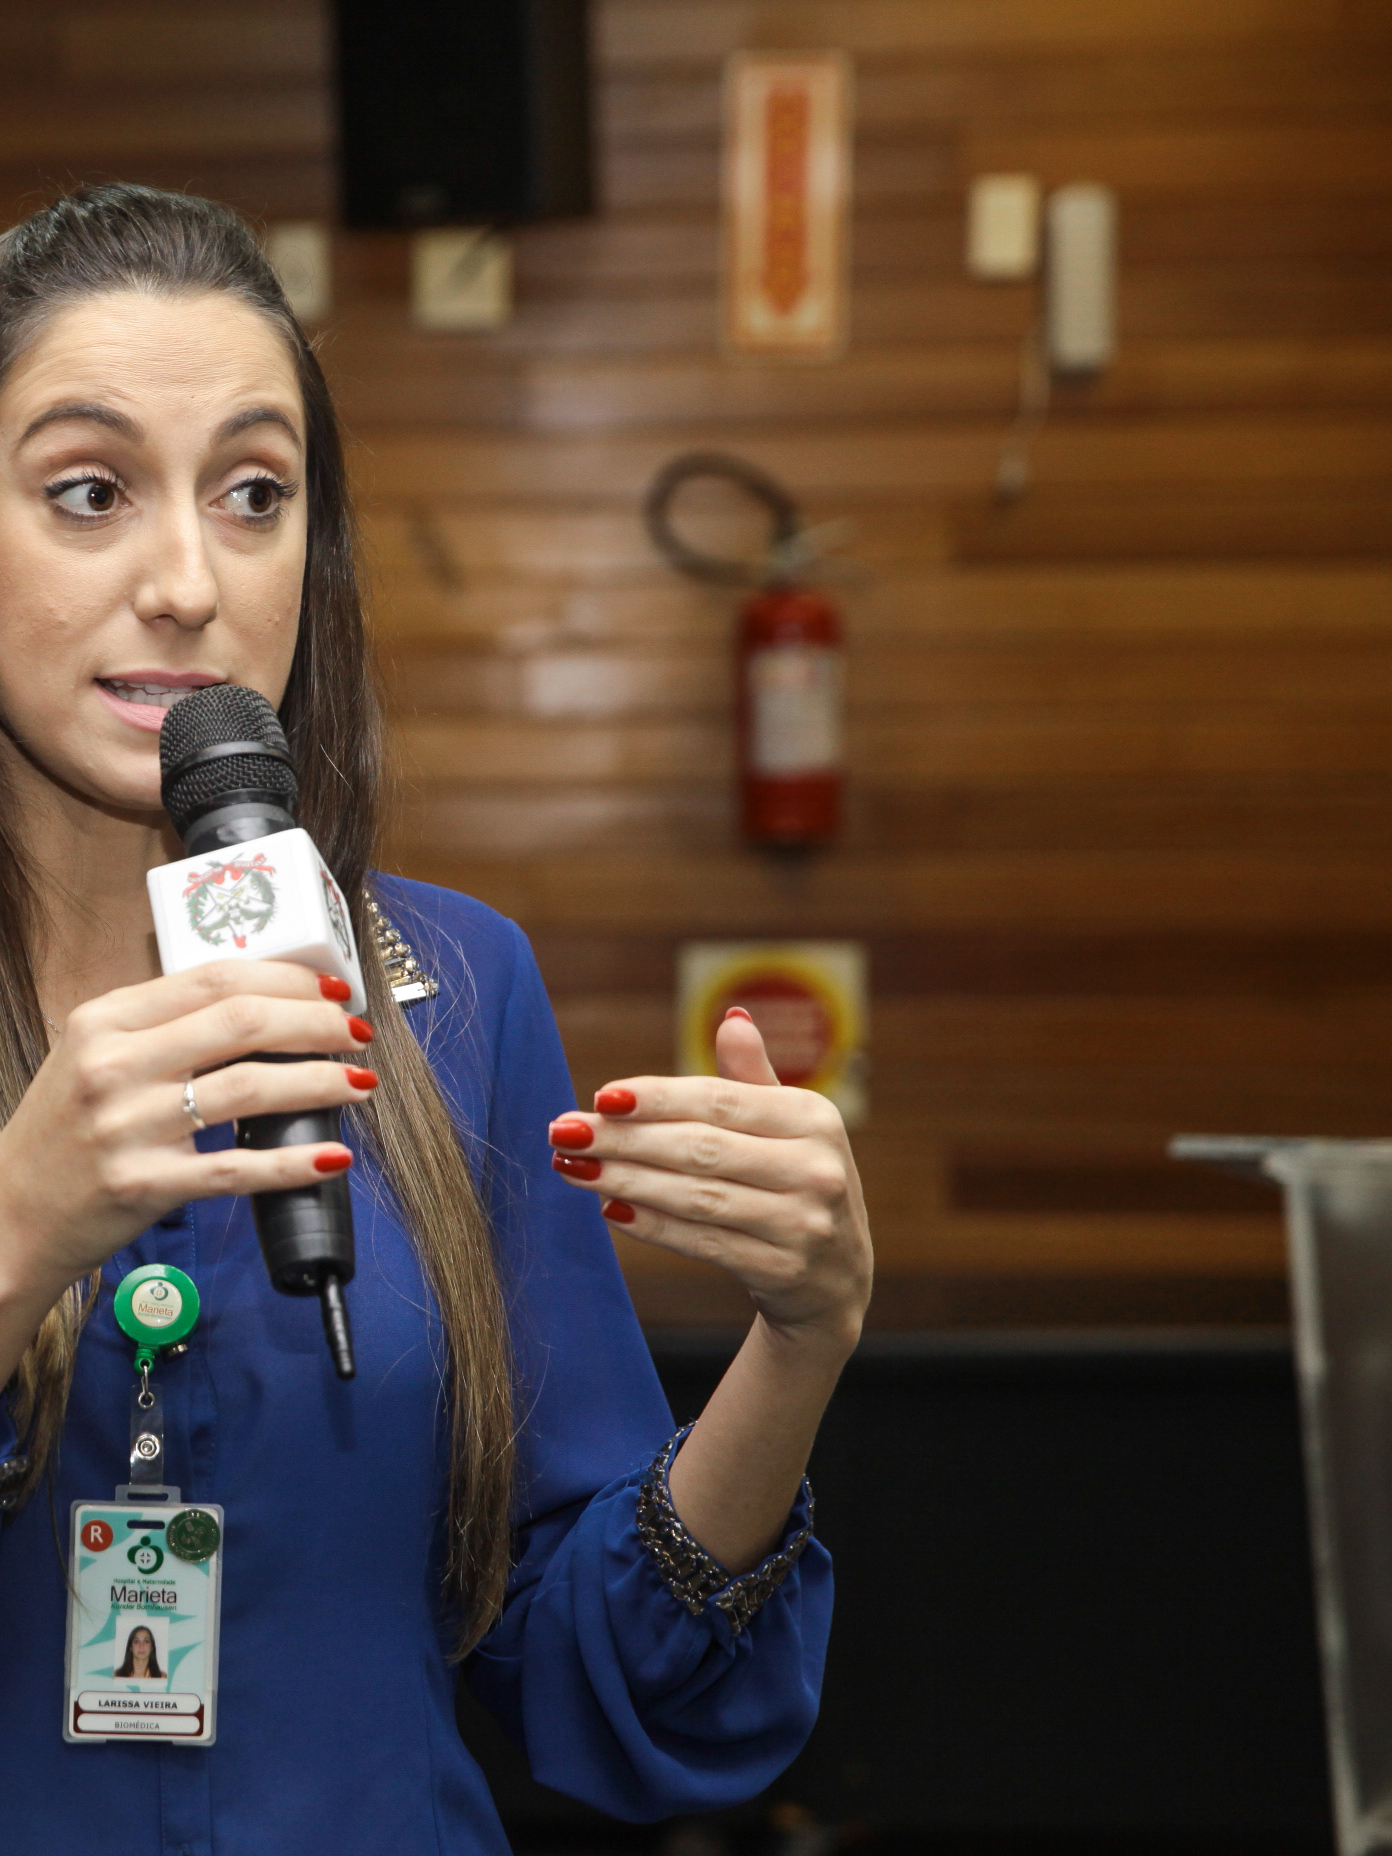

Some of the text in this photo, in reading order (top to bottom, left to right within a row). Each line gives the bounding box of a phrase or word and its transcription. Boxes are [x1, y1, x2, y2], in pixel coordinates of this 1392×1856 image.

[138, 1303, 173, 1317] Marieta
[90, 1525, 104, 1543] R
[110, 1585, 177, 1604] Marieta
[98, 1700, 178, 1709] LARISSA VIEIRA
[114, 1720, 160, 1729] BIOMÉDICA
